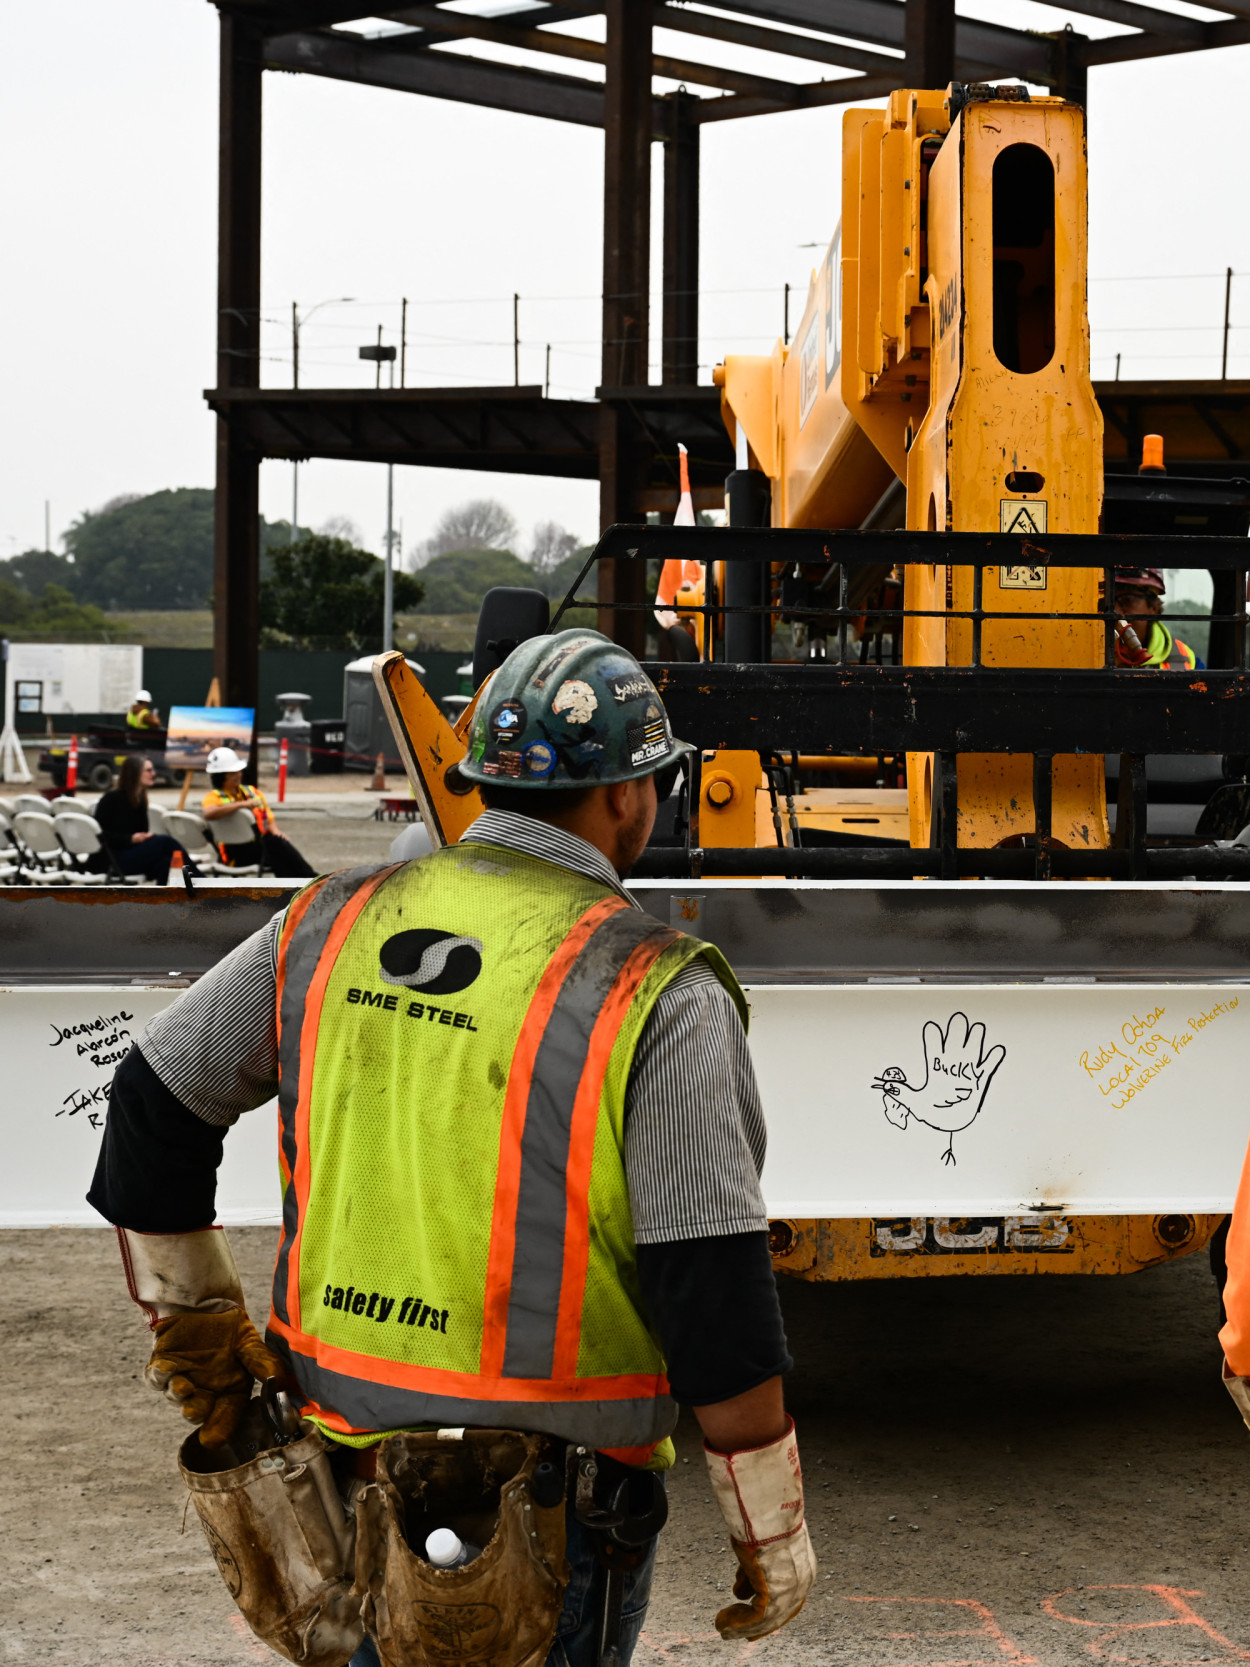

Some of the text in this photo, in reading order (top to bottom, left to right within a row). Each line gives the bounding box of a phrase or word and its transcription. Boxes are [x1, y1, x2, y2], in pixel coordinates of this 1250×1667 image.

[49, 1010, 133, 1046] Jacqueline
[346, 988, 478, 1032] SME STEEL
[1079, 1042, 1127, 1078] Rudy
[1138, 1034, 1172, 1058] 709
[323, 1284, 449, 1334] safety first
